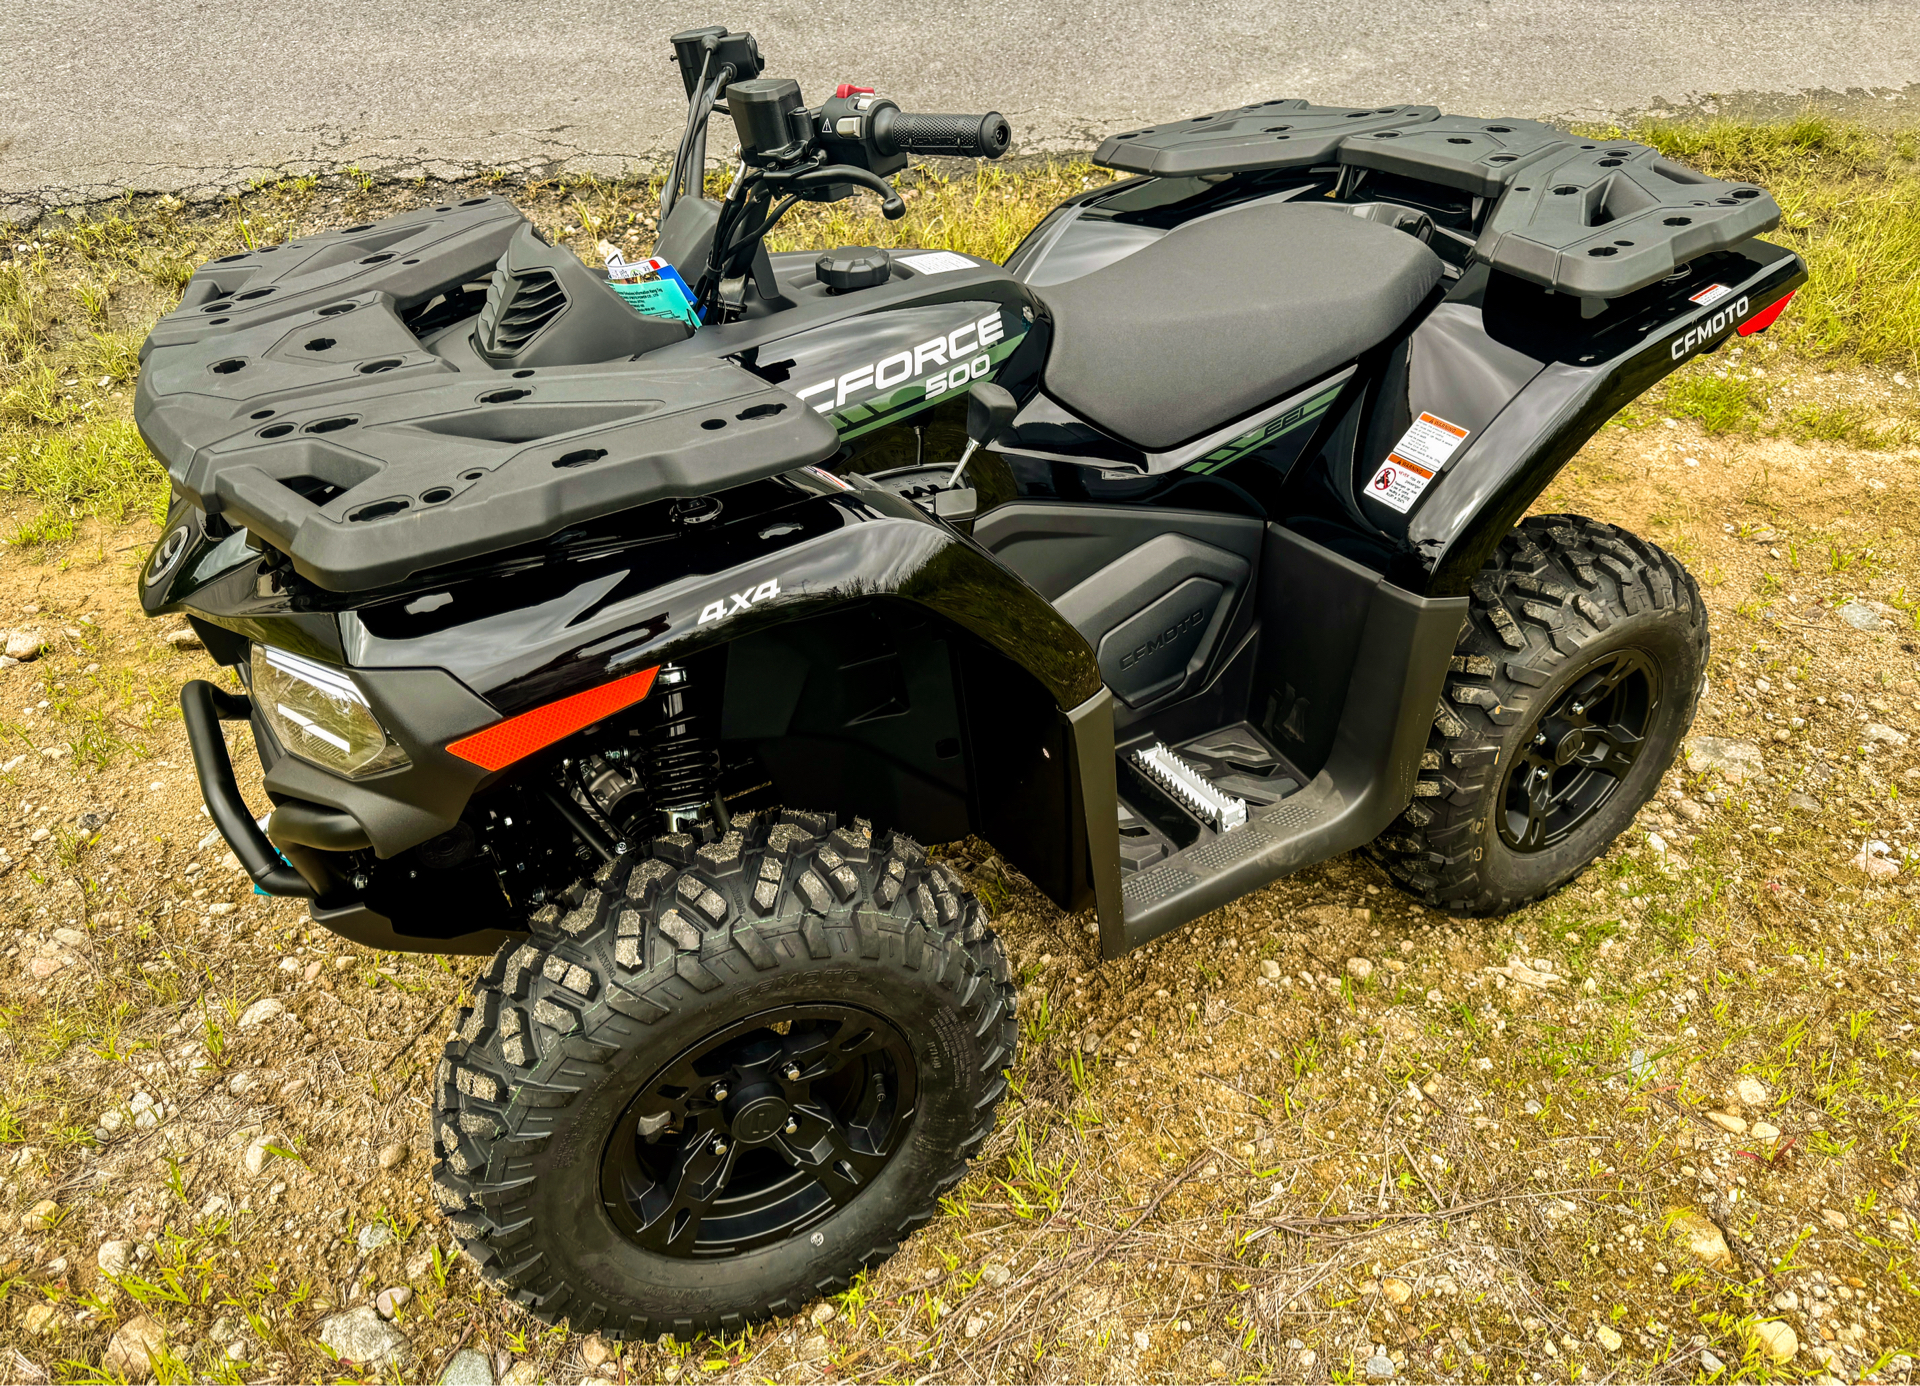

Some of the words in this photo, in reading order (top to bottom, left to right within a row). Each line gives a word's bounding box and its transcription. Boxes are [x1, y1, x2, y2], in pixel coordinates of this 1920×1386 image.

[1671, 295, 1749, 360] CFMOTO
[796, 311, 1004, 414] CFORCE
[925, 353, 990, 400] 500
[1264, 407, 1305, 437] EFI
[698, 578, 781, 625] 4X4
[1119, 608, 1205, 672] CFMOTO
[733, 968, 862, 1004] CFMOTO
